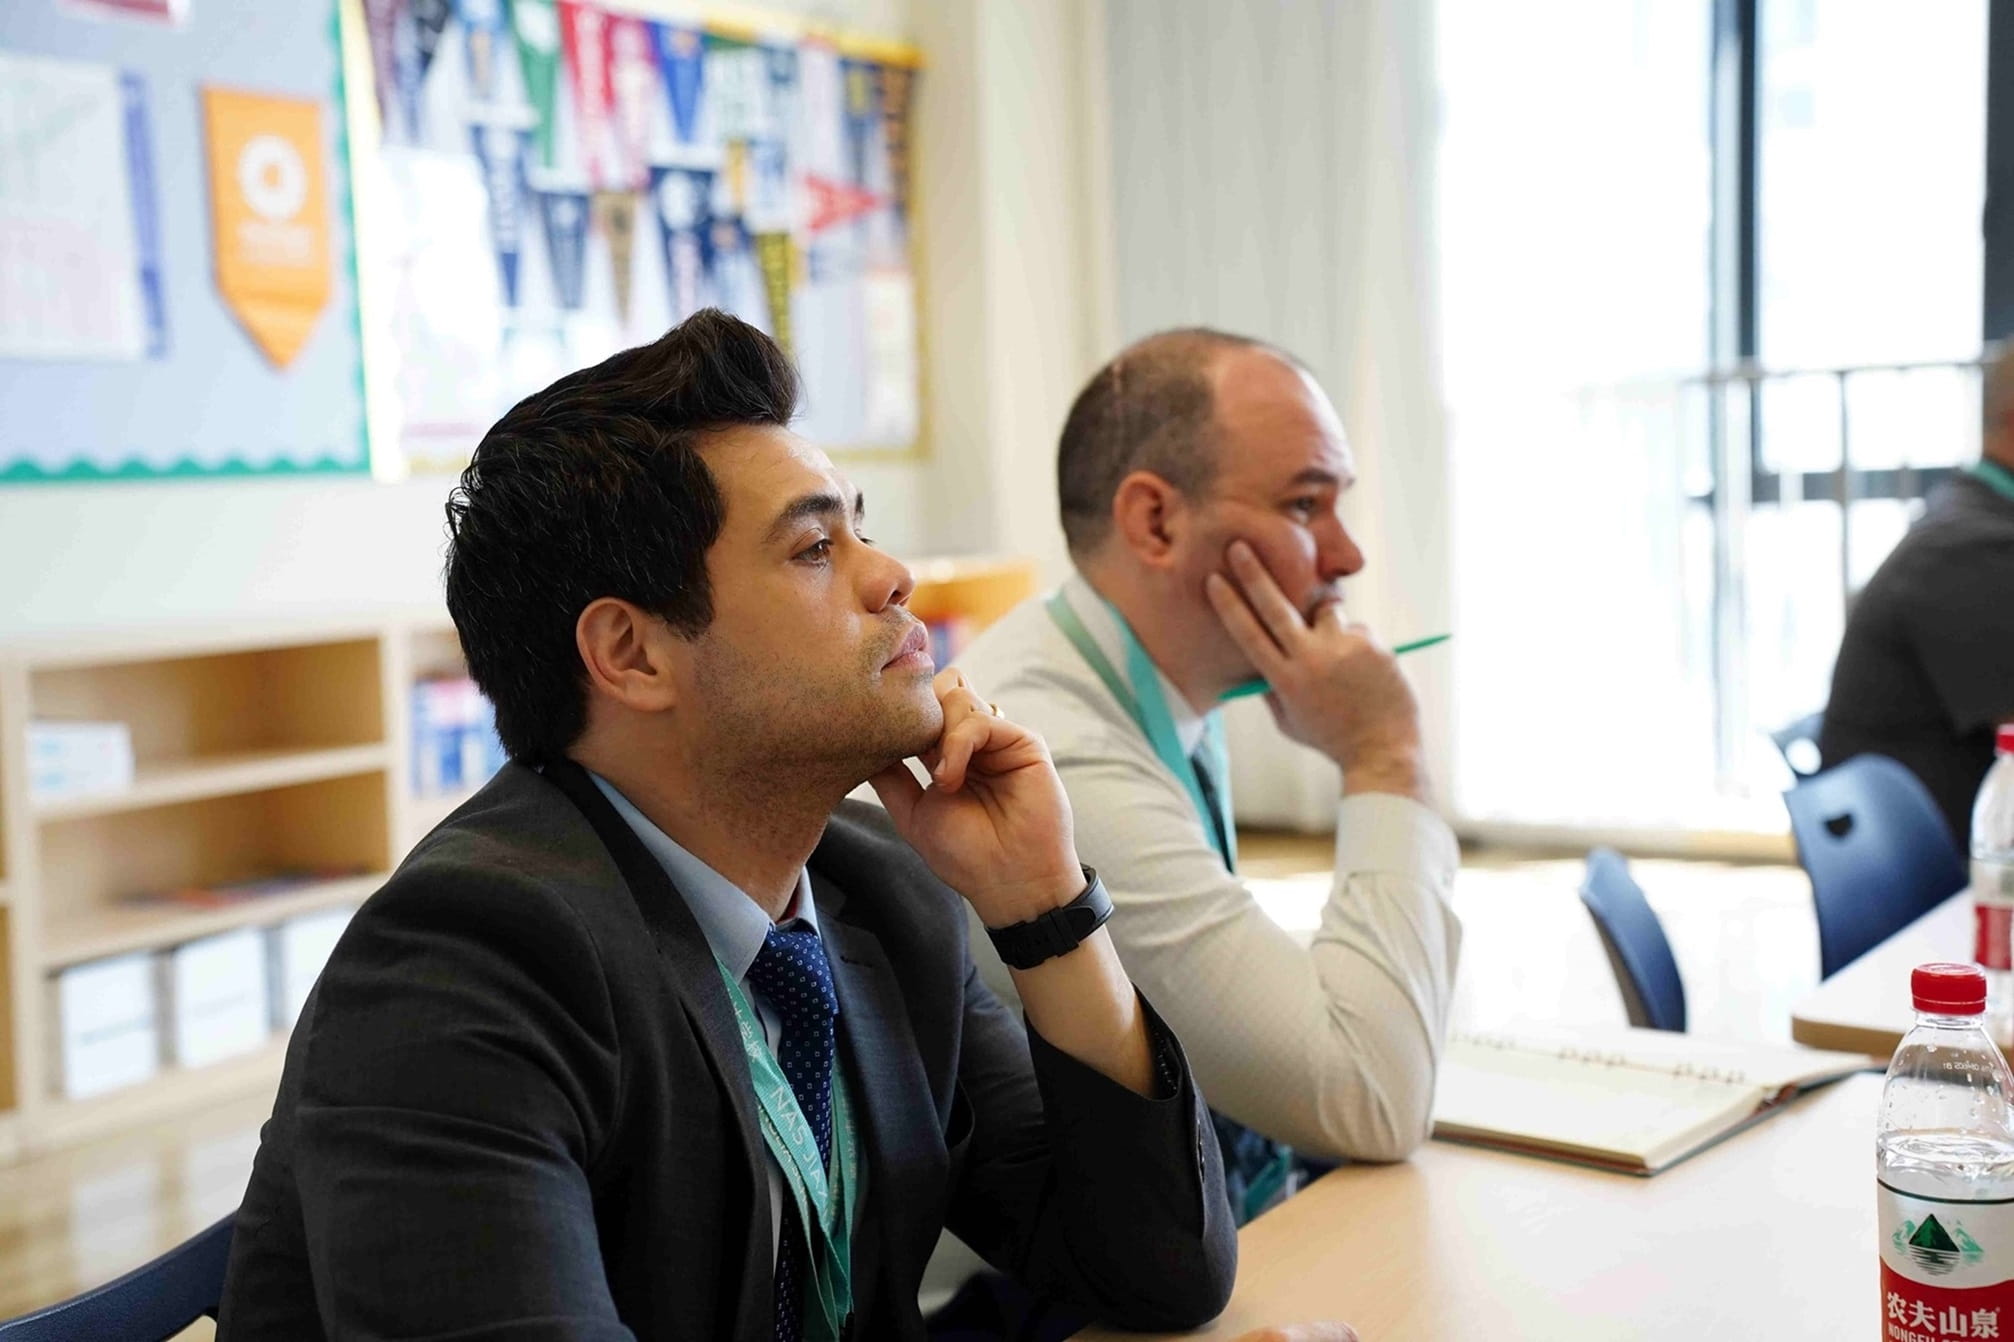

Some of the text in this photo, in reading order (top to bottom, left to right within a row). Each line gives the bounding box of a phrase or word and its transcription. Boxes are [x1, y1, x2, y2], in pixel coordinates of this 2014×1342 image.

[771, 1085, 806, 1144] NAS
[1887, 1291, 1999, 1338] 农夫山泉
